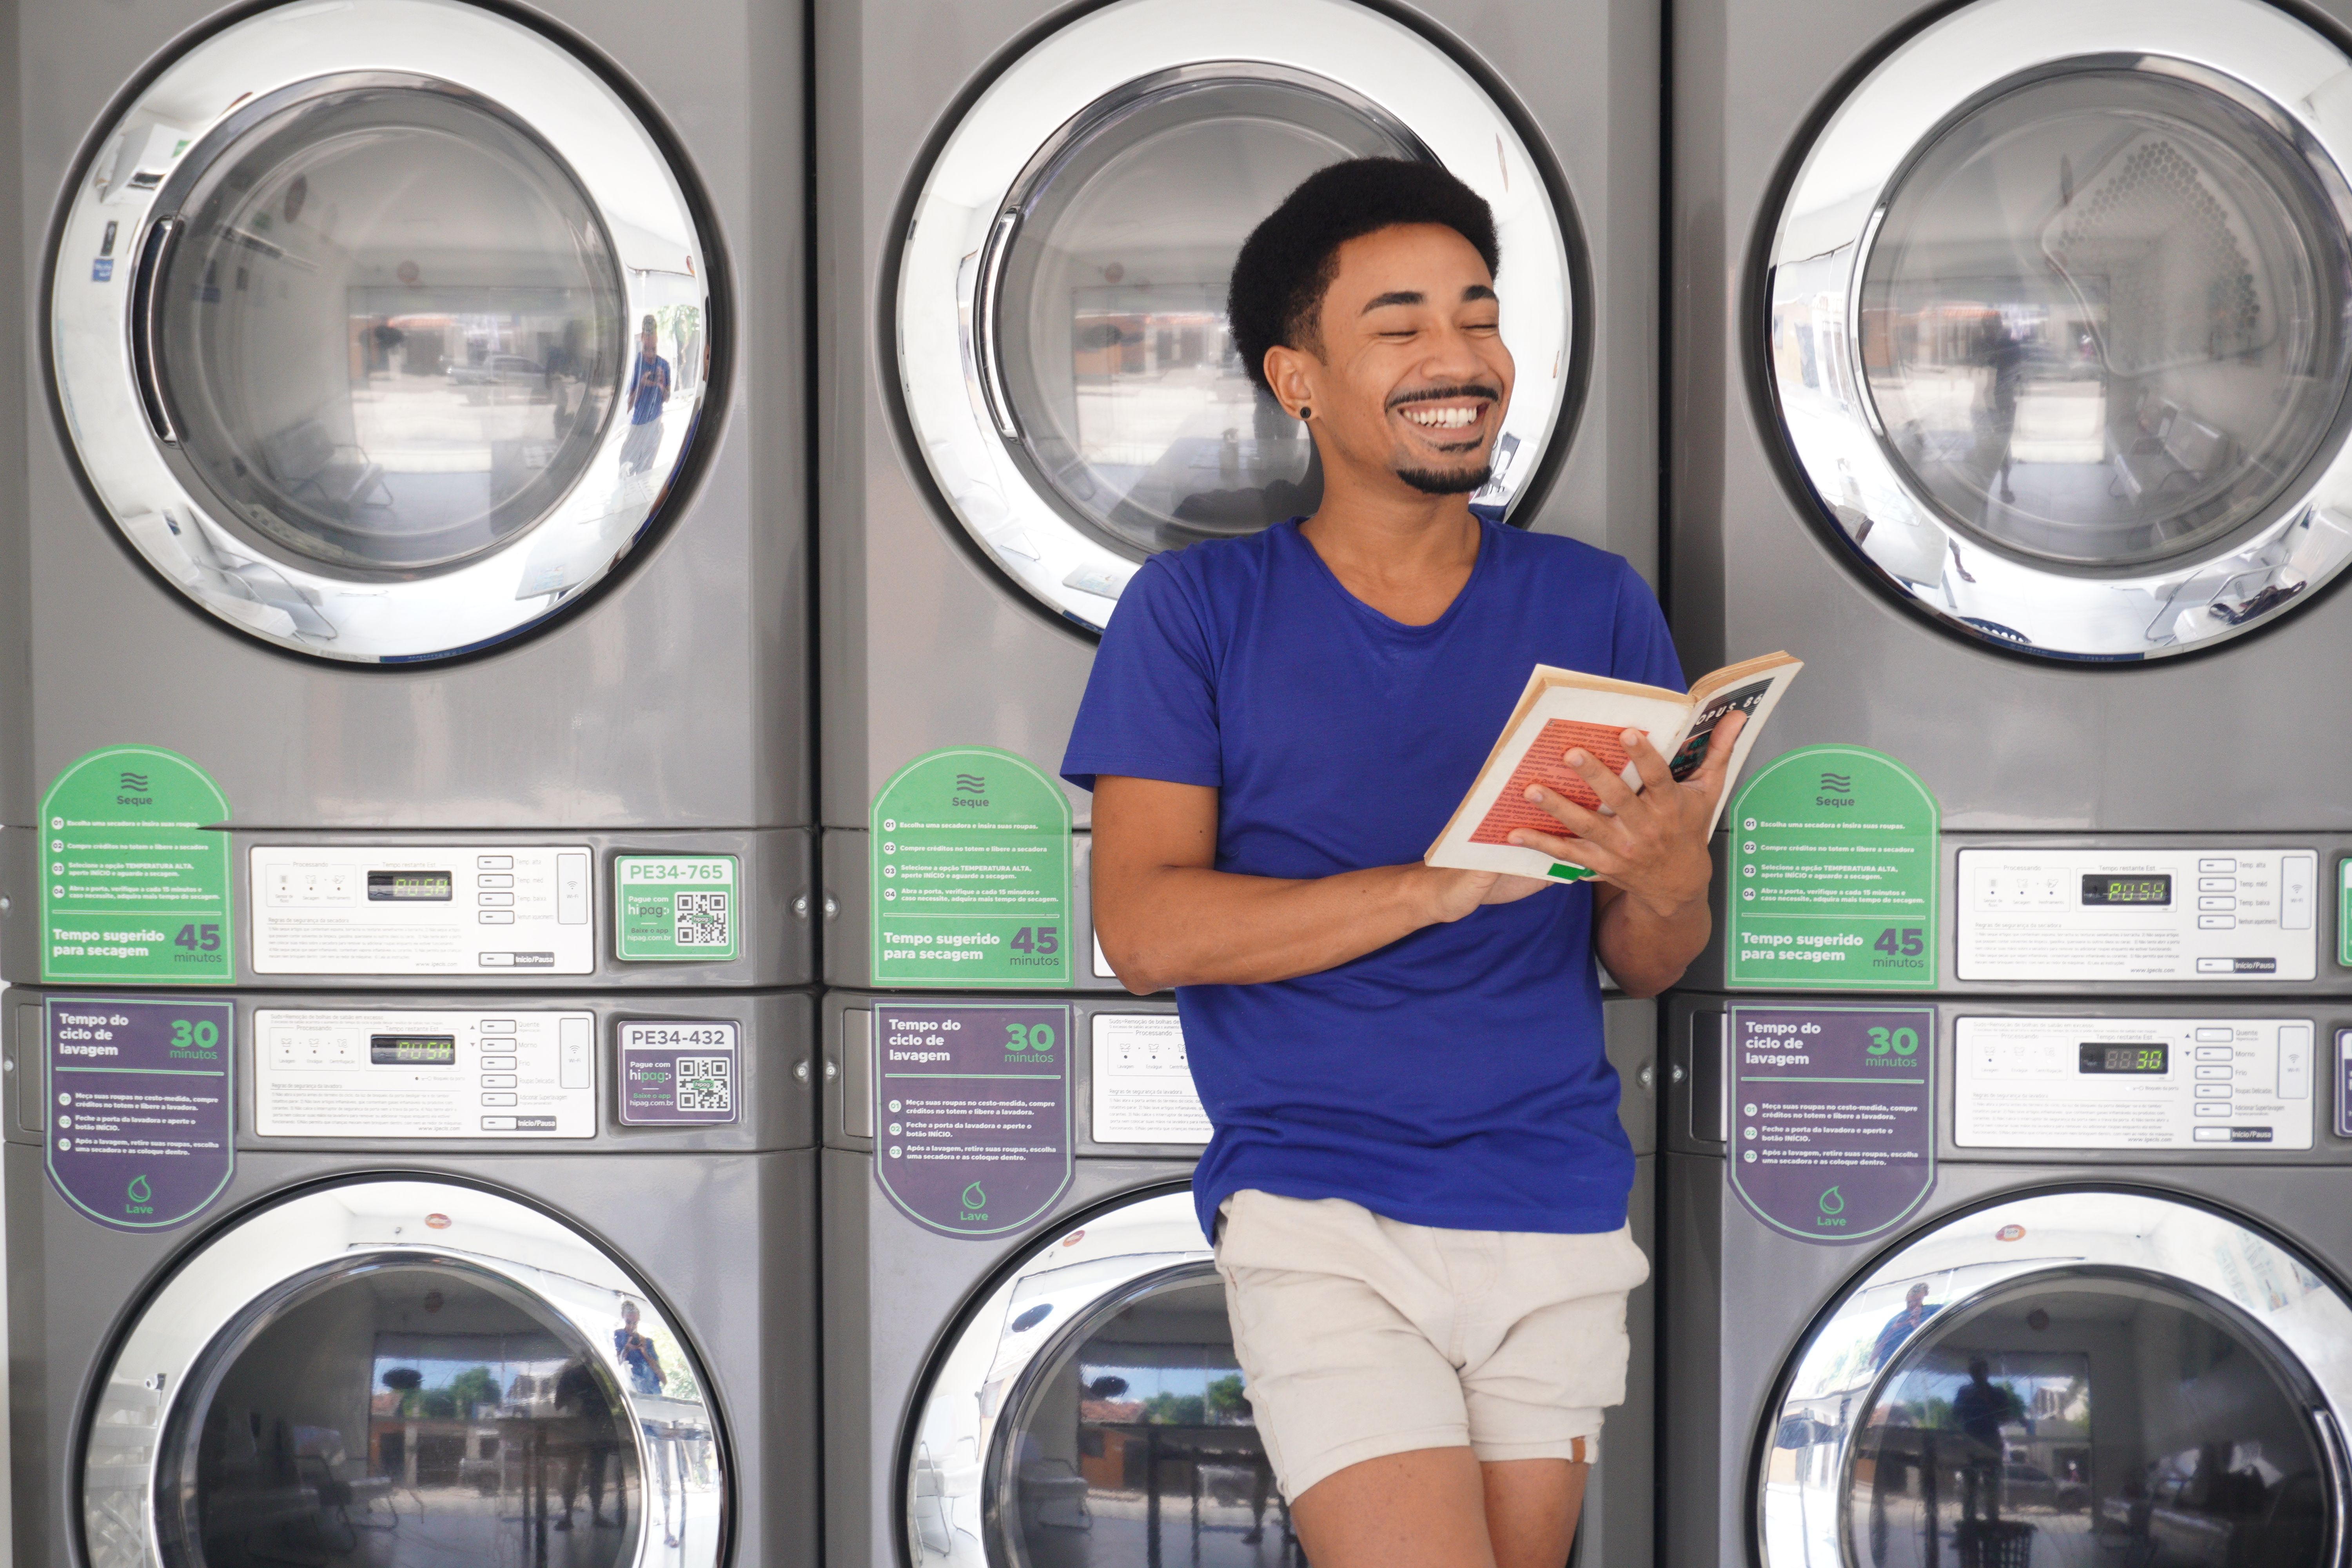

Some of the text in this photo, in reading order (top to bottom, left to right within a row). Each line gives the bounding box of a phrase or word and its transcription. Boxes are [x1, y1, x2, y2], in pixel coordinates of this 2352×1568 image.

[1696, 693, 1764, 726] OPUS 86
[117, 795, 152, 806] Seque
[952, 797, 989, 808] Seque
[1816, 796, 1855, 808] Seque
[630, 865, 722, 879] PE34-765
[394, 878, 448, 897] PUSH
[2109, 883, 2164, 901] PUSH
[628, 896, 651, 905] Pague
[53, 929, 165, 943] Tempo sugerido
[174, 924, 220, 951] 45
[884, 932, 1000, 946] Tempo sugerido
[1010, 927, 1058, 954] 45
[1741, 932, 1863, 947] Tempo sugerido
[1874, 928, 1924, 956] 45
[53, 946, 149, 958] para secagem
[174, 953, 221, 963] minutos
[884, 950, 983, 962] para secagem
[1742, 950, 1845, 962] para secagem
[1010, 956, 1059, 965] minutos
[1873, 957, 1924, 967] minutos
[60, 1013, 129, 1027] Tempo do
[889, 1019, 961, 1032] Tempo do
[60, 1027, 113, 1040] ciclo de
[171, 1020, 218, 1047] 30
[1746, 1022, 1821, 1036] Tempo do
[632, 1030, 724, 1044] PE34-432
[889, 1033, 944, 1045] ciclo de
[1005, 1023, 1054, 1051] 30
[1746, 1036, 1803, 1049] ciclo de
[1867, 1027, 1918, 1055] 30
[60, 1043, 118, 1057] lavagem
[169, 1050, 218, 1059] minutos
[397, 1042, 451, 1060] PUSH
[889, 1049, 950, 1063] lavagem
[1005, 1052, 1053, 1062] minutos
[1746, 1052, 1809, 1066] lavagem
[1865, 1057, 1917, 1067] minutos
[2137, 1051, 2162, 1069] 30
[125, 1205, 152, 1214] Lave
[960, 1211, 987, 1221] Lave
[1817, 1217, 1846, 1225] Lave
